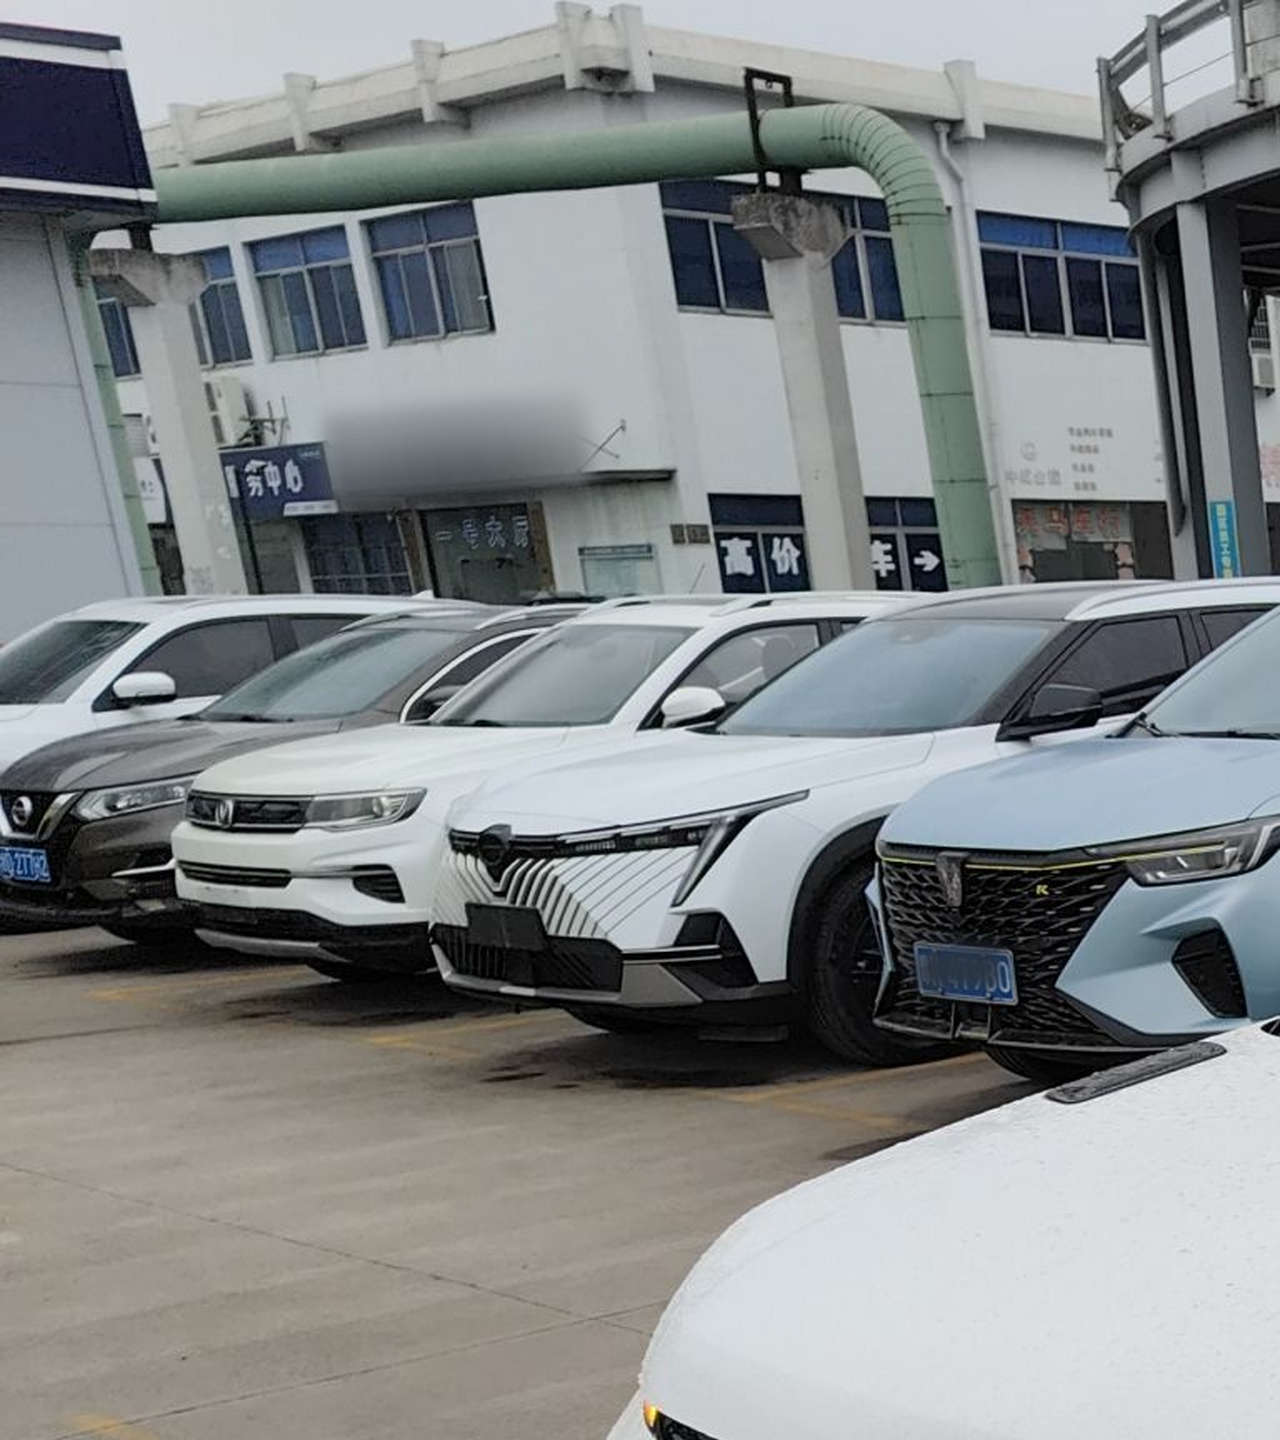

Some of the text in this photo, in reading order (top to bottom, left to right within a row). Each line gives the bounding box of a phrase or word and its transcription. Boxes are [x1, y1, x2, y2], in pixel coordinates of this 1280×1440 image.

[224, 459, 303, 498] 务中心
[719, 537, 801, 576] 高价
